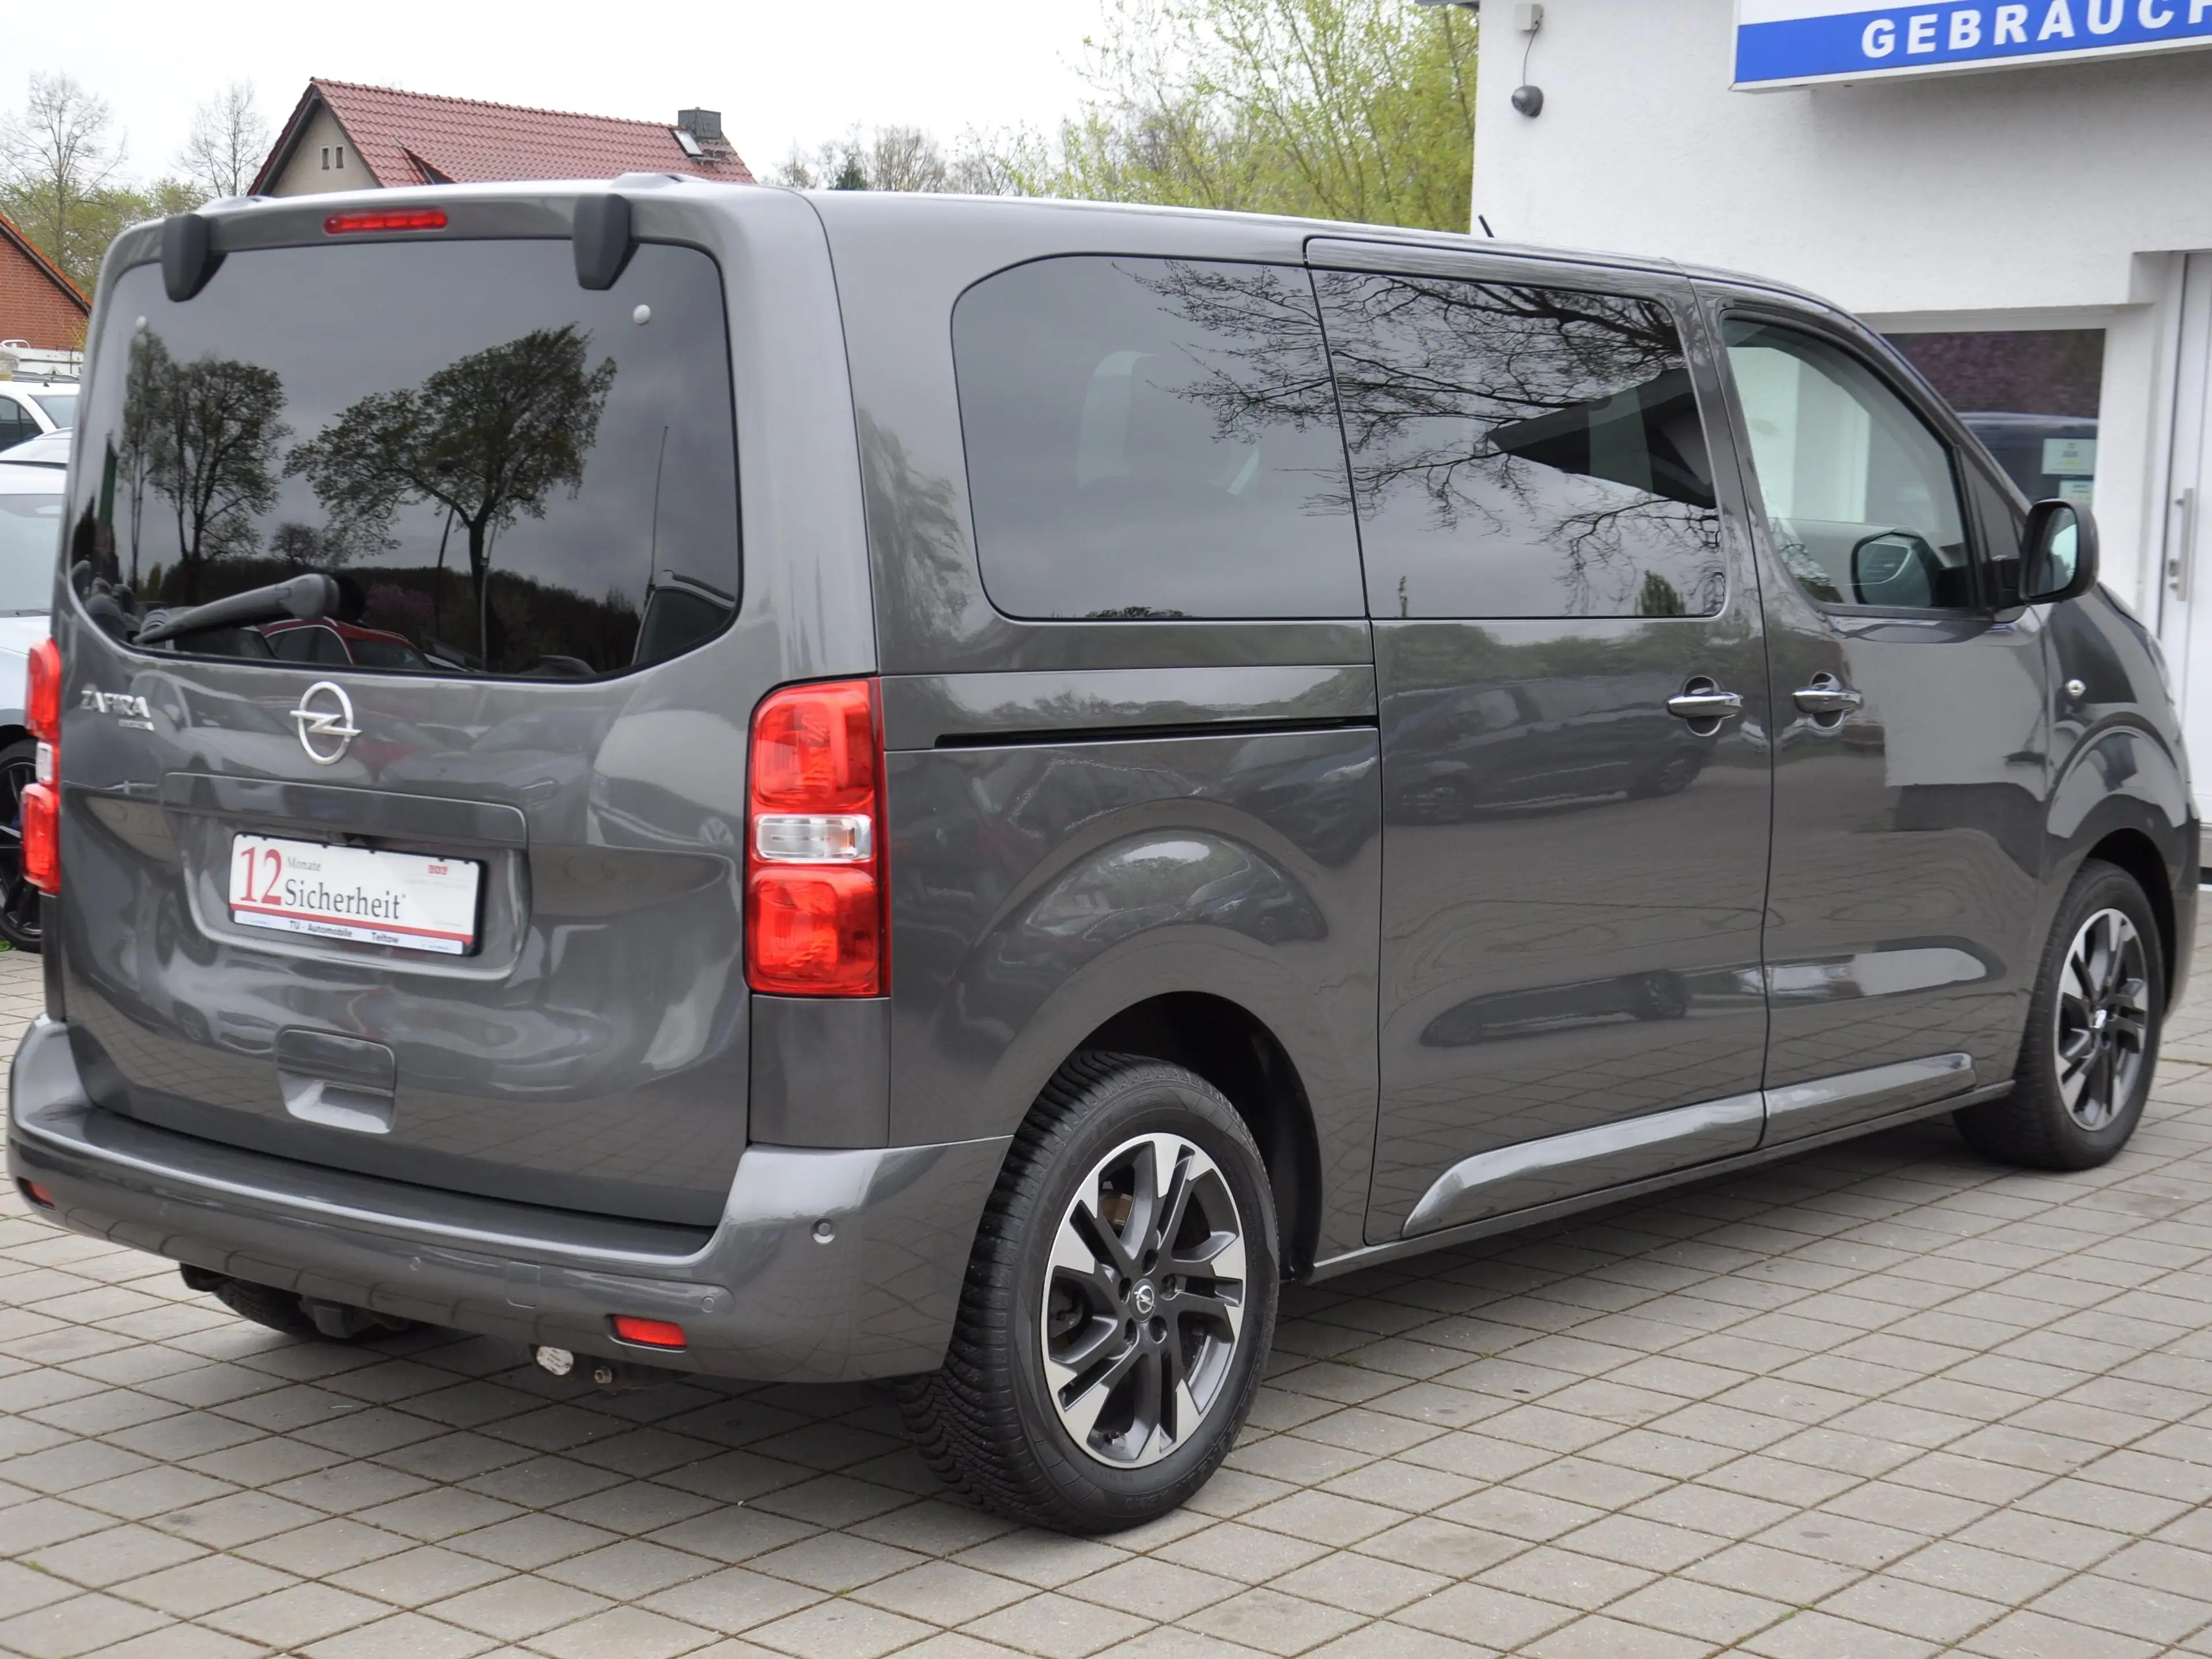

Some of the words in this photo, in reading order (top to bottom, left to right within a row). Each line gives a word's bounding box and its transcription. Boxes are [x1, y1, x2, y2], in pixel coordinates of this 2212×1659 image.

[80, 690, 151, 718] ZAFIRA
[240, 846, 282, 906] 12
[307, 923, 353, 938] Automobile
